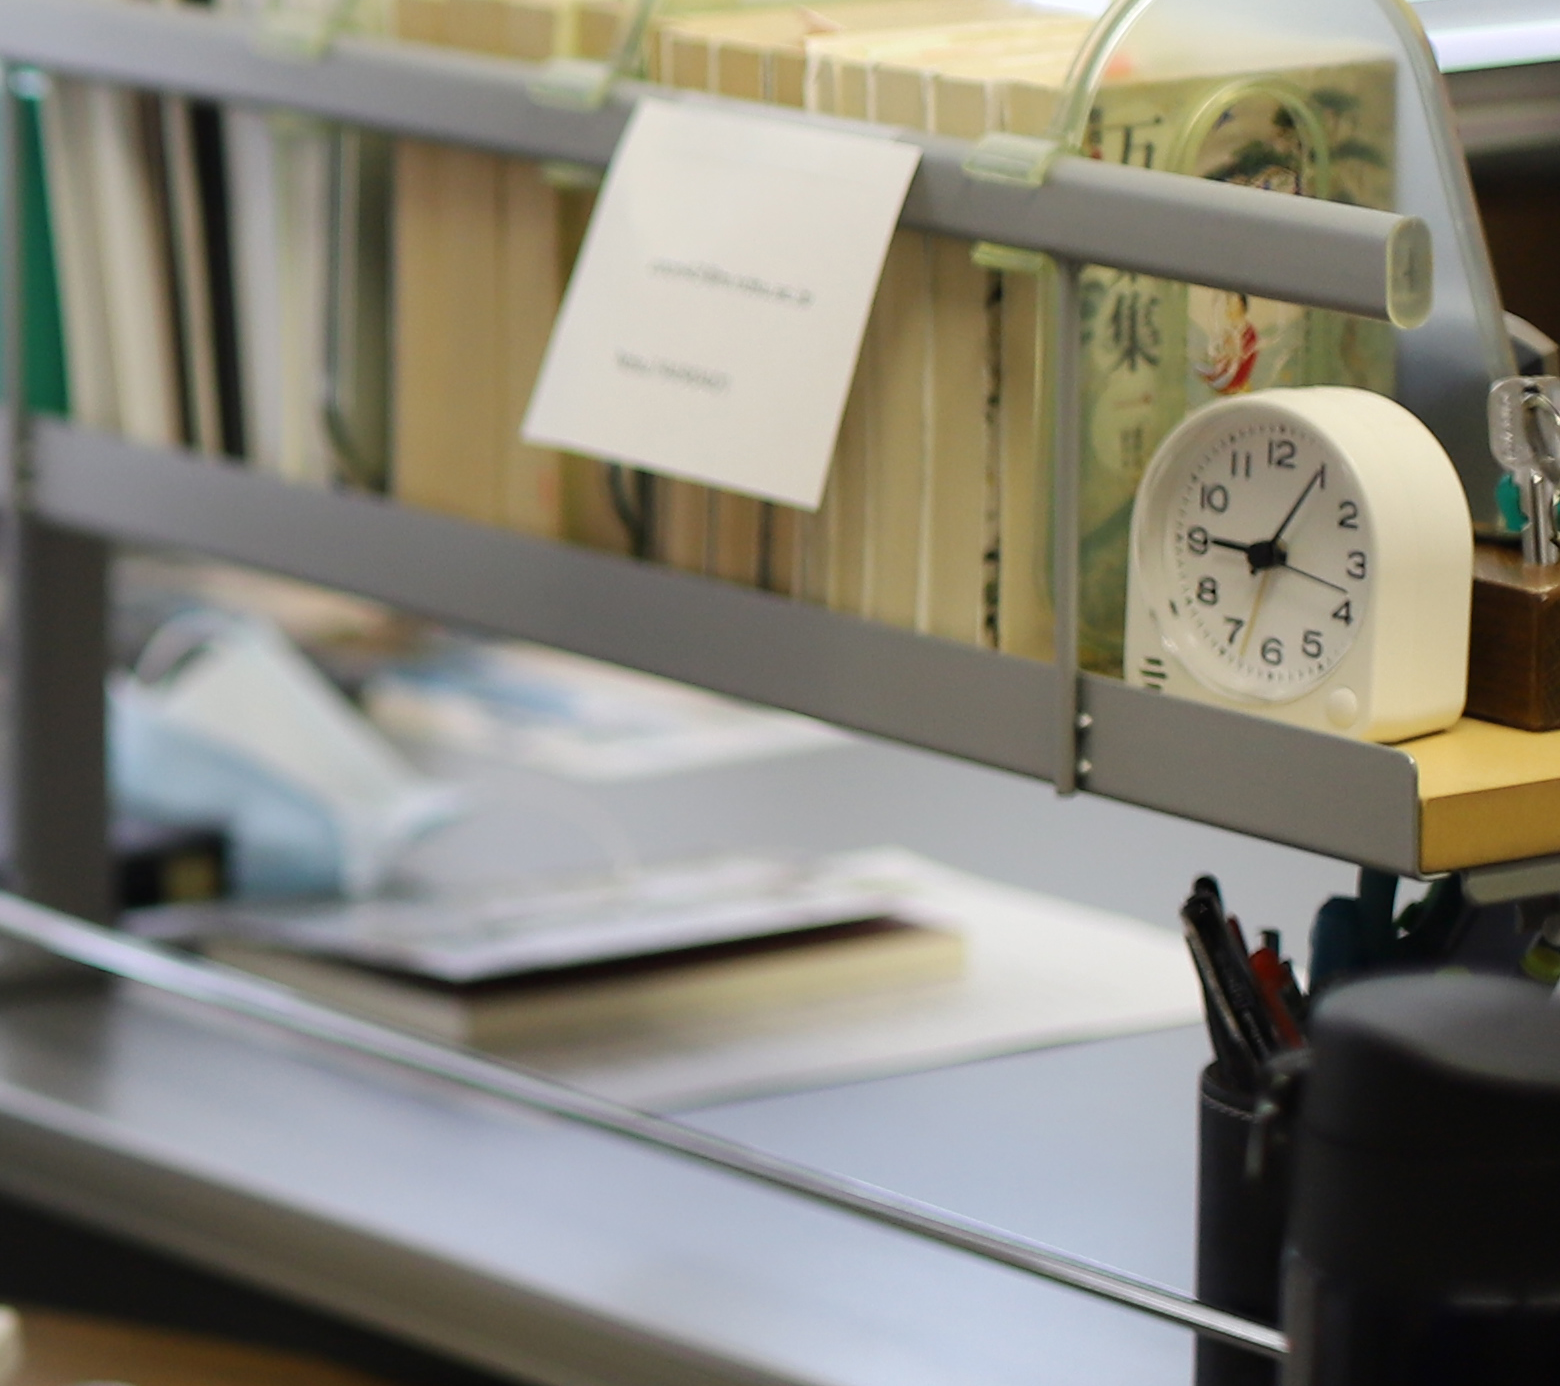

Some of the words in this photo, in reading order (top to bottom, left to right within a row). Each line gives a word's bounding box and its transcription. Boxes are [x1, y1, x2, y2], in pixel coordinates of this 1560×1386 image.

[1231, 451, 1251, 479] 11
[1267, 440, 1297, 469] 12
[1200, 484, 1230, 514] 10
[1337, 500, 1359, 530] 2
[1188, 526, 1209, 556] 9
[1346, 551, 1367, 581] 3
[1196, 576, 1219, 607] 8
[1331, 598, 1354, 627] 4
[1224, 616, 1245, 646] 7
[1302, 629, 1323, 660] 5
[1260, 637, 1283, 666] 6
